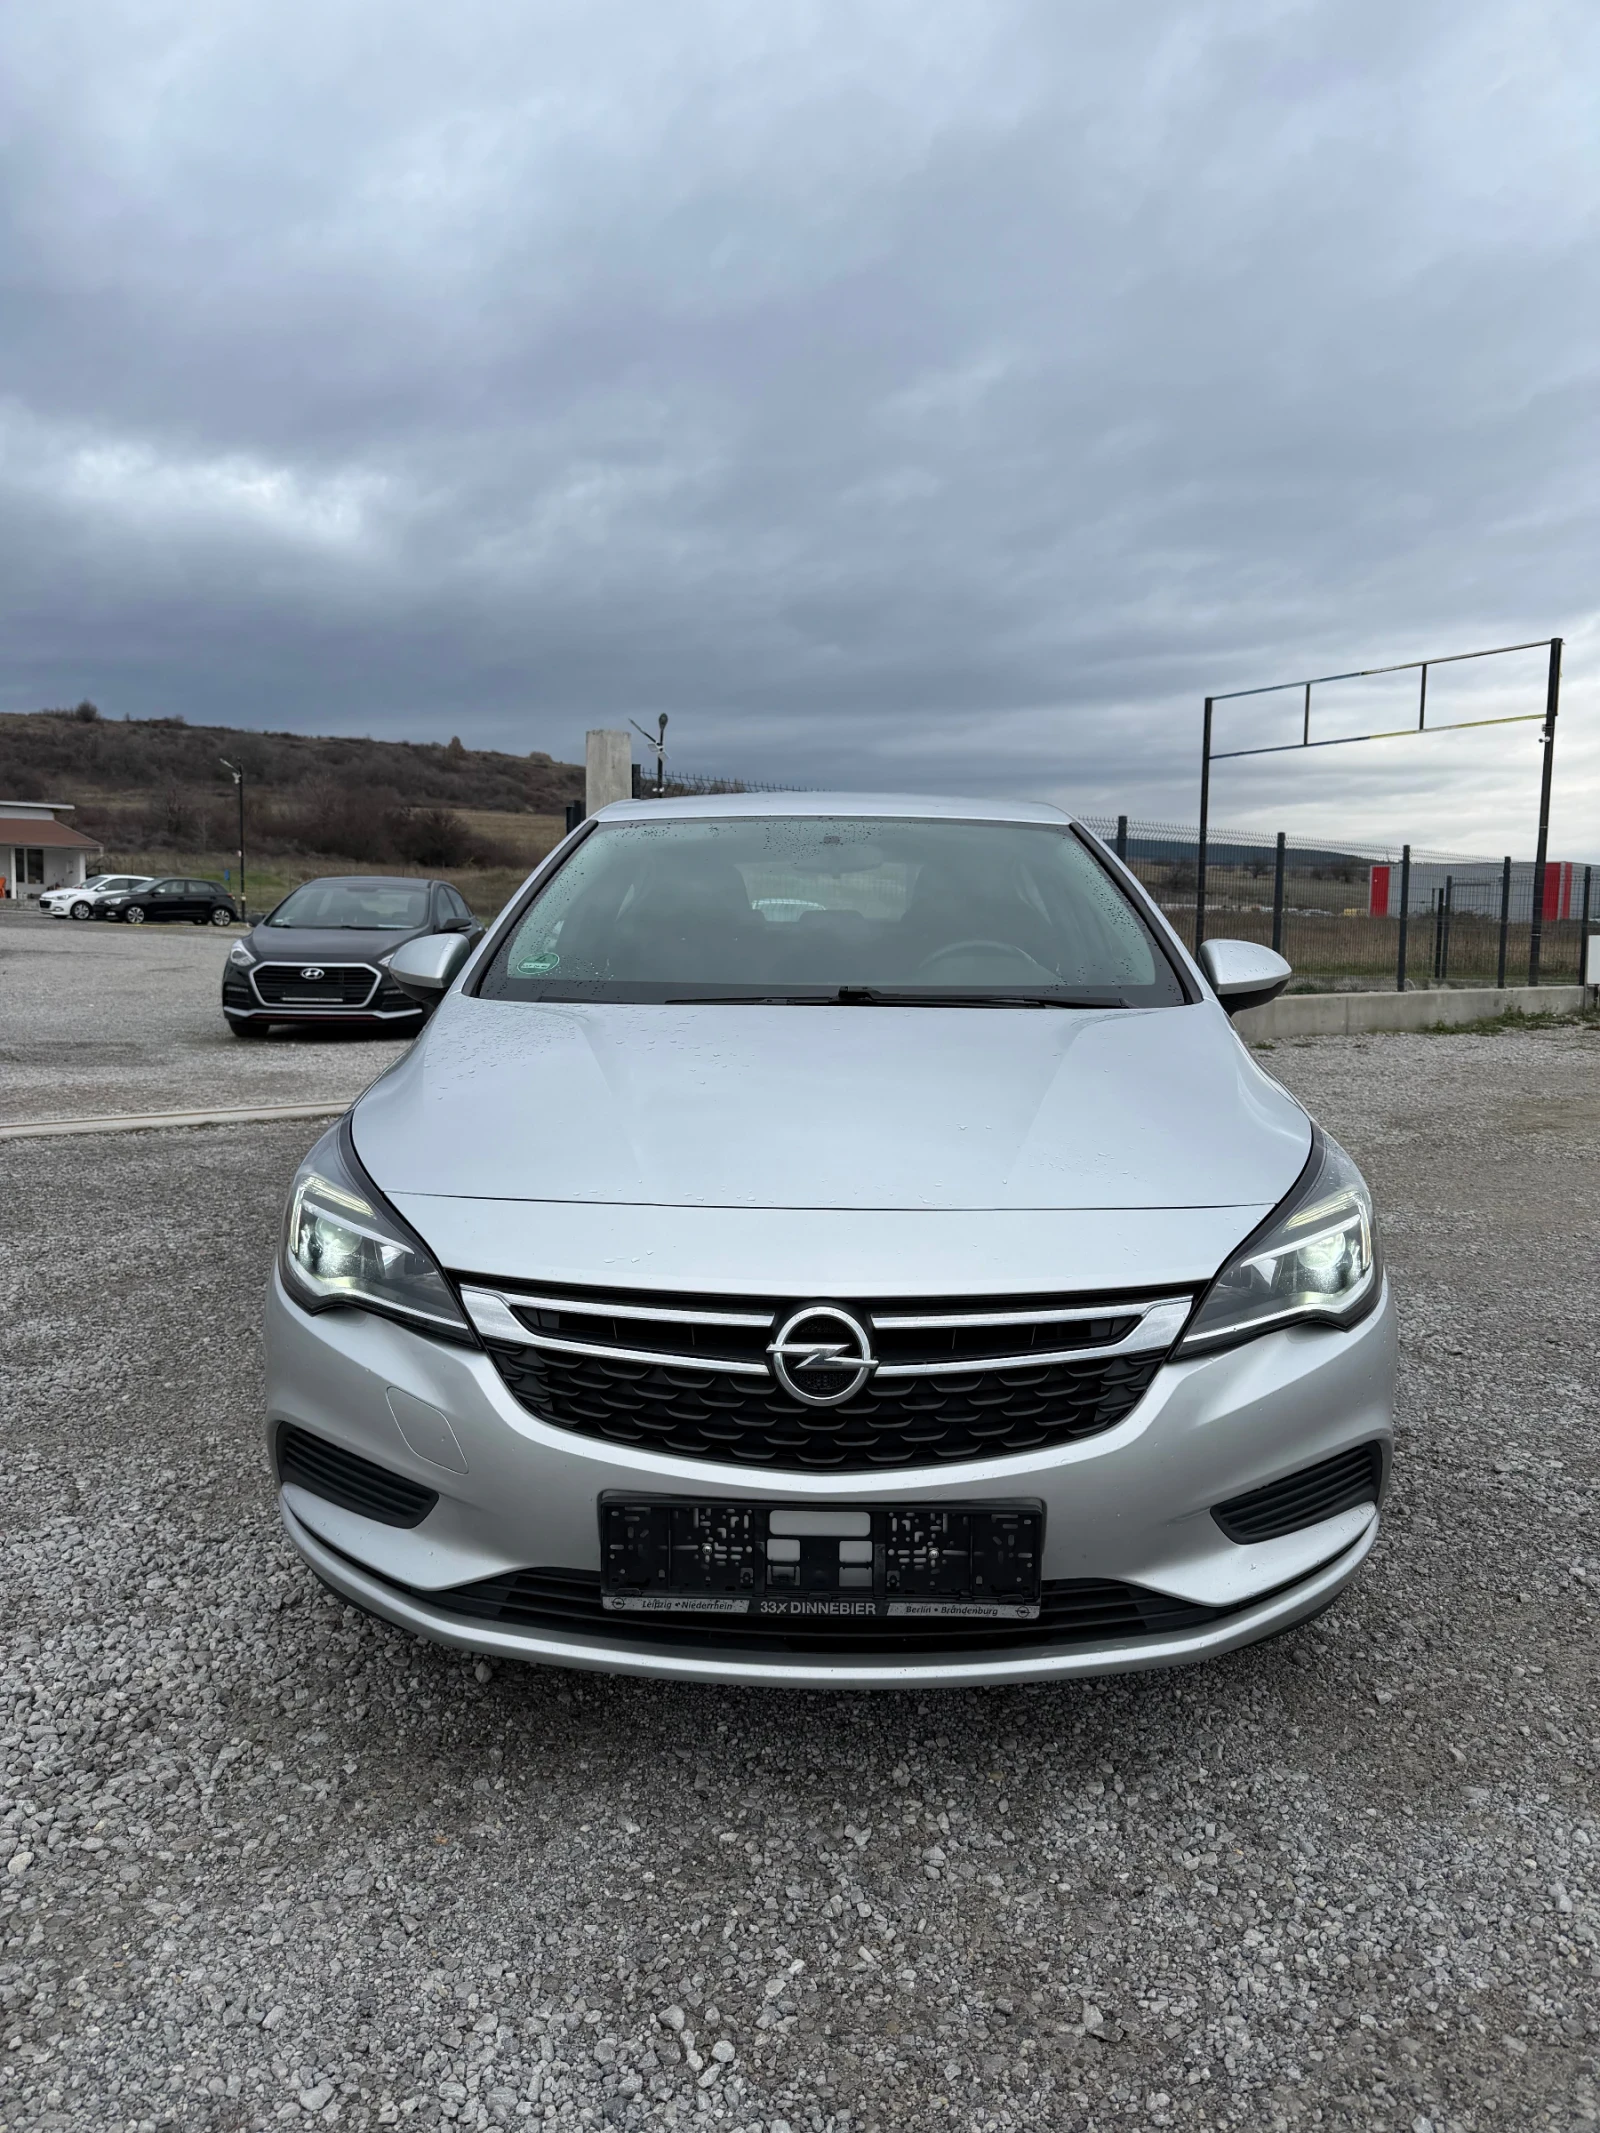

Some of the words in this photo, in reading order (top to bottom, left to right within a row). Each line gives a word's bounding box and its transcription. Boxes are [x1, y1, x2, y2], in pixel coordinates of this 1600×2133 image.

[642, 1600, 672, 1610] Leipzig
[681, 1600, 733, 1610] Niederrhein
[790, 1601, 876, 1615] DINNEBIER
[906, 1605, 931, 1613] Berlin
[940, 1605, 998, 1616] Brandenburg
